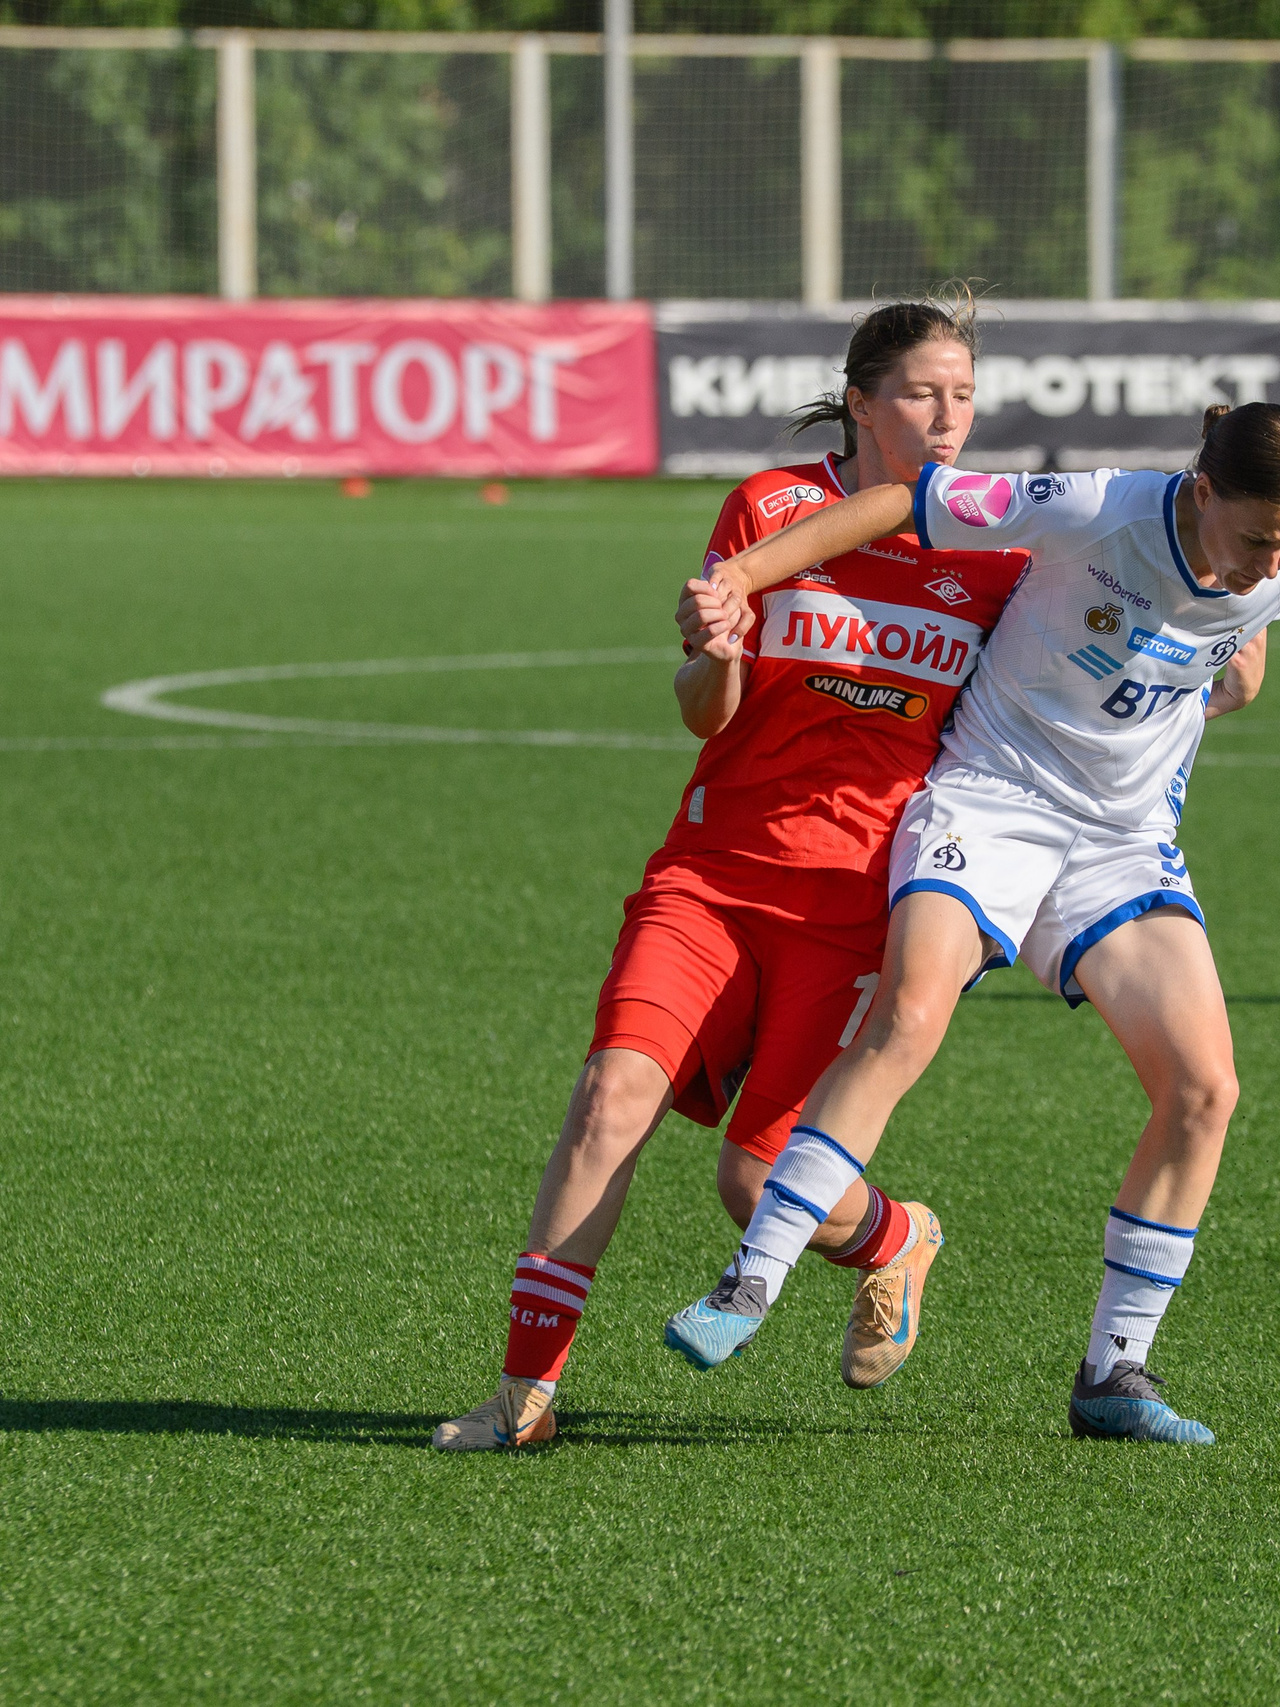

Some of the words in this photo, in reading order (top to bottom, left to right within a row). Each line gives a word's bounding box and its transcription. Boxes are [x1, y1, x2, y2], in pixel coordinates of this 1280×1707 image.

[0, 337, 578, 444] МИРАТОРГ
[956, 499, 971, 520] ЛИГА
[962, 493, 980, 518] СУПЕР
[794, 570, 836, 585] JÖGEL
[1087, 563, 1153, 611] wildberries
[782, 610, 969, 676] ЛУКОЙЛ
[1132, 634, 1193, 662] БЕТСИТИ
[813, 677, 906, 710] WINLINE
